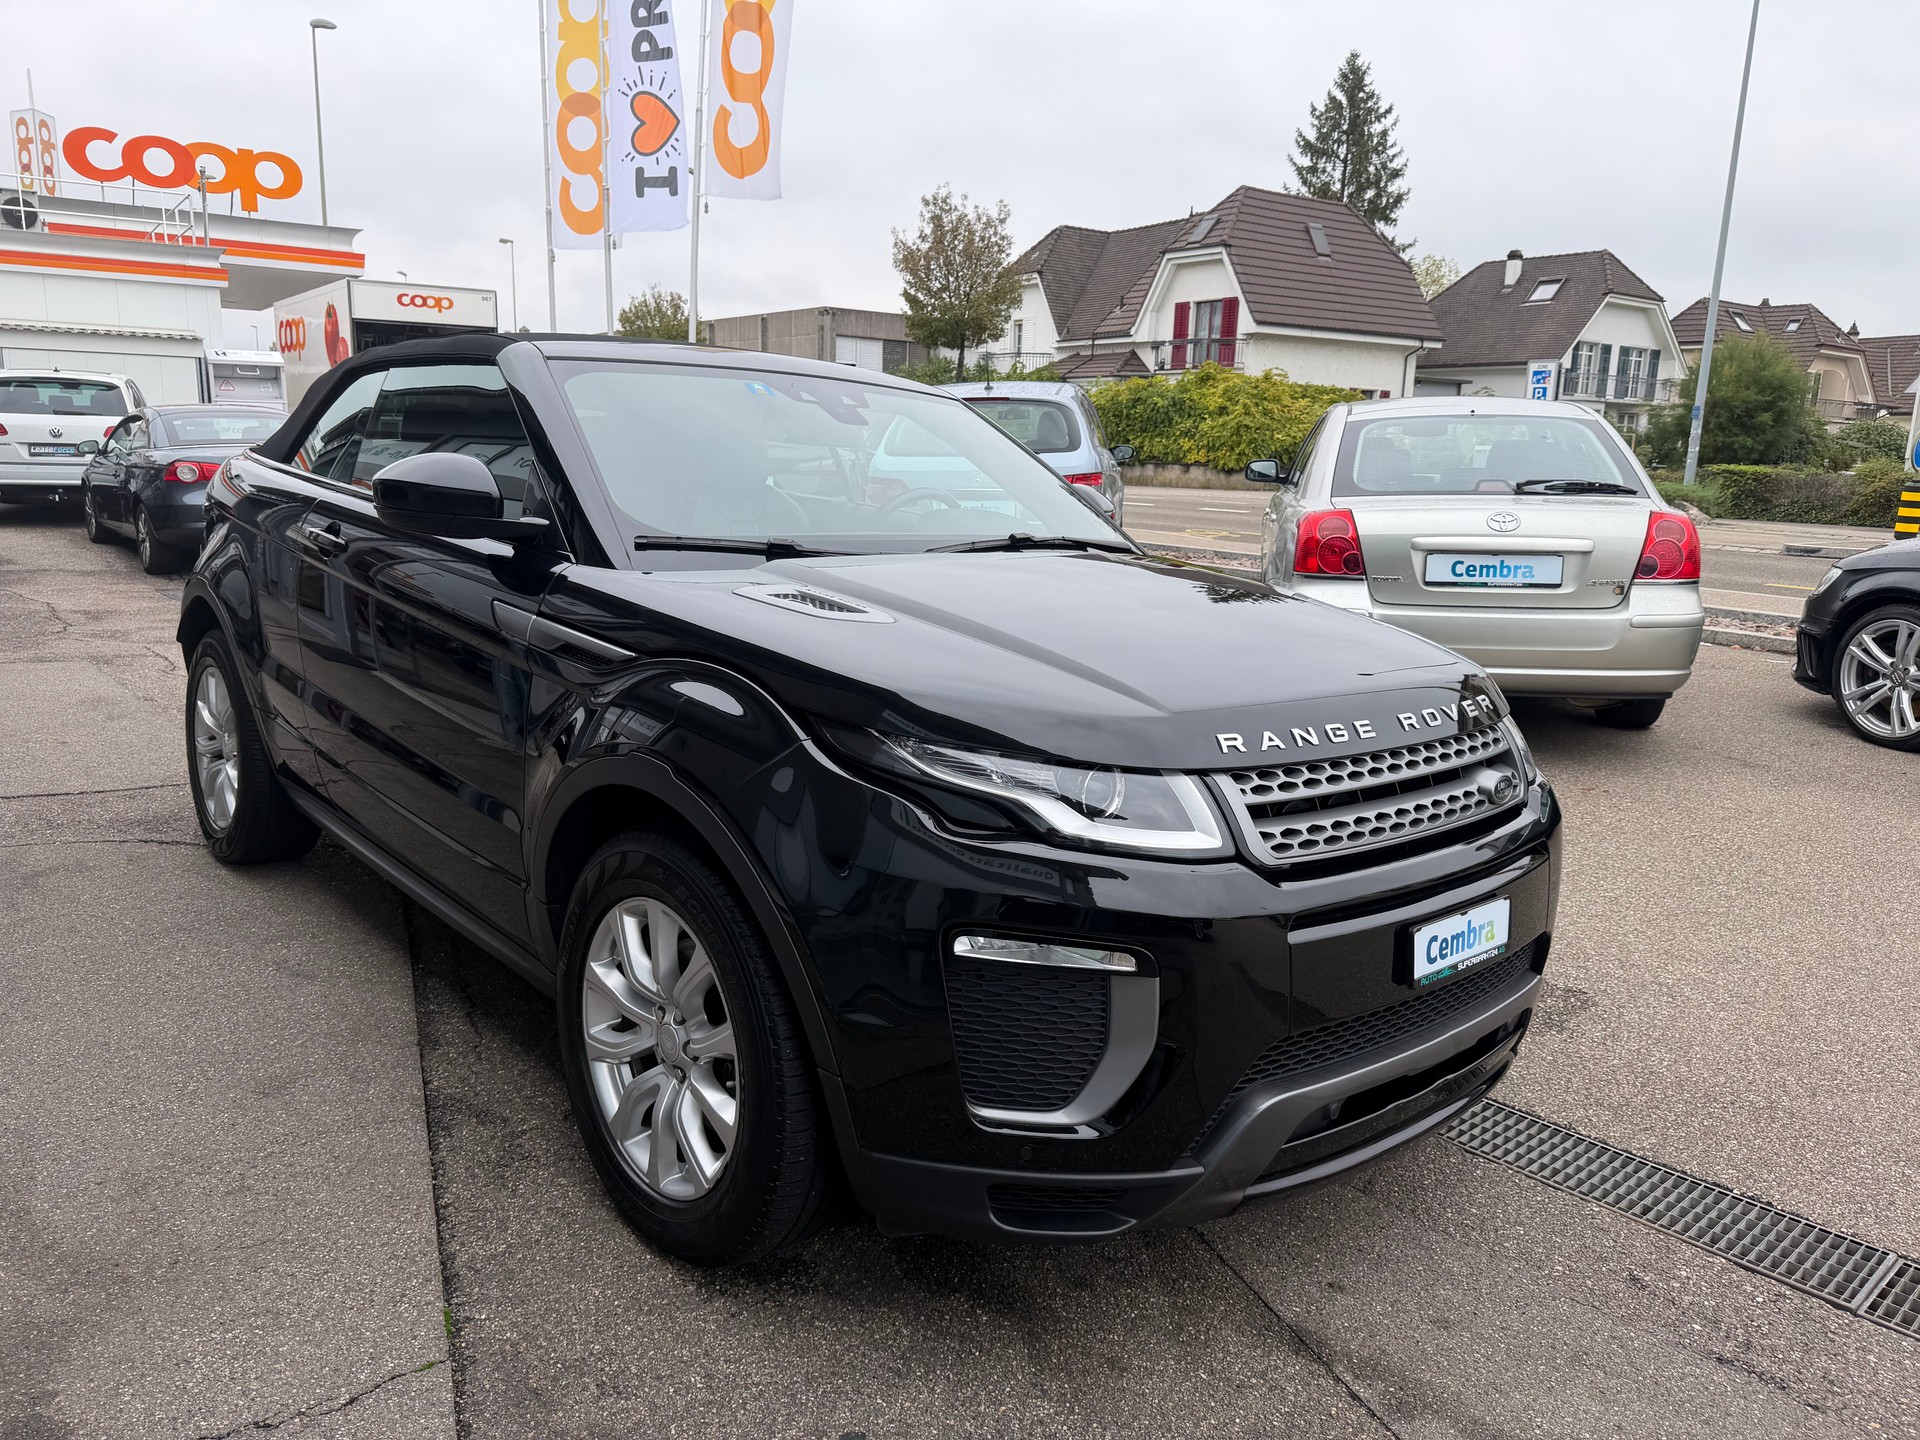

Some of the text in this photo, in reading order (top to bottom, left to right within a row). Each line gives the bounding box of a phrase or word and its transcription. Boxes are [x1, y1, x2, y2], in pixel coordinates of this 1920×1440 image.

[713, 0, 776, 180] co
[16, 116, 34, 190] oop
[38, 118, 56, 197] oop
[62, 126, 303, 212] coop
[635, 166, 679, 198] I
[396, 293, 454, 313] coop
[279, 316, 306, 361] coop
[1451, 559, 1535, 579] Cembra
[1215, 694, 1494, 754] RANGE ROVER
[1426, 919, 1495, 965] Cembra
[1420, 973, 1438, 986] AUTO
